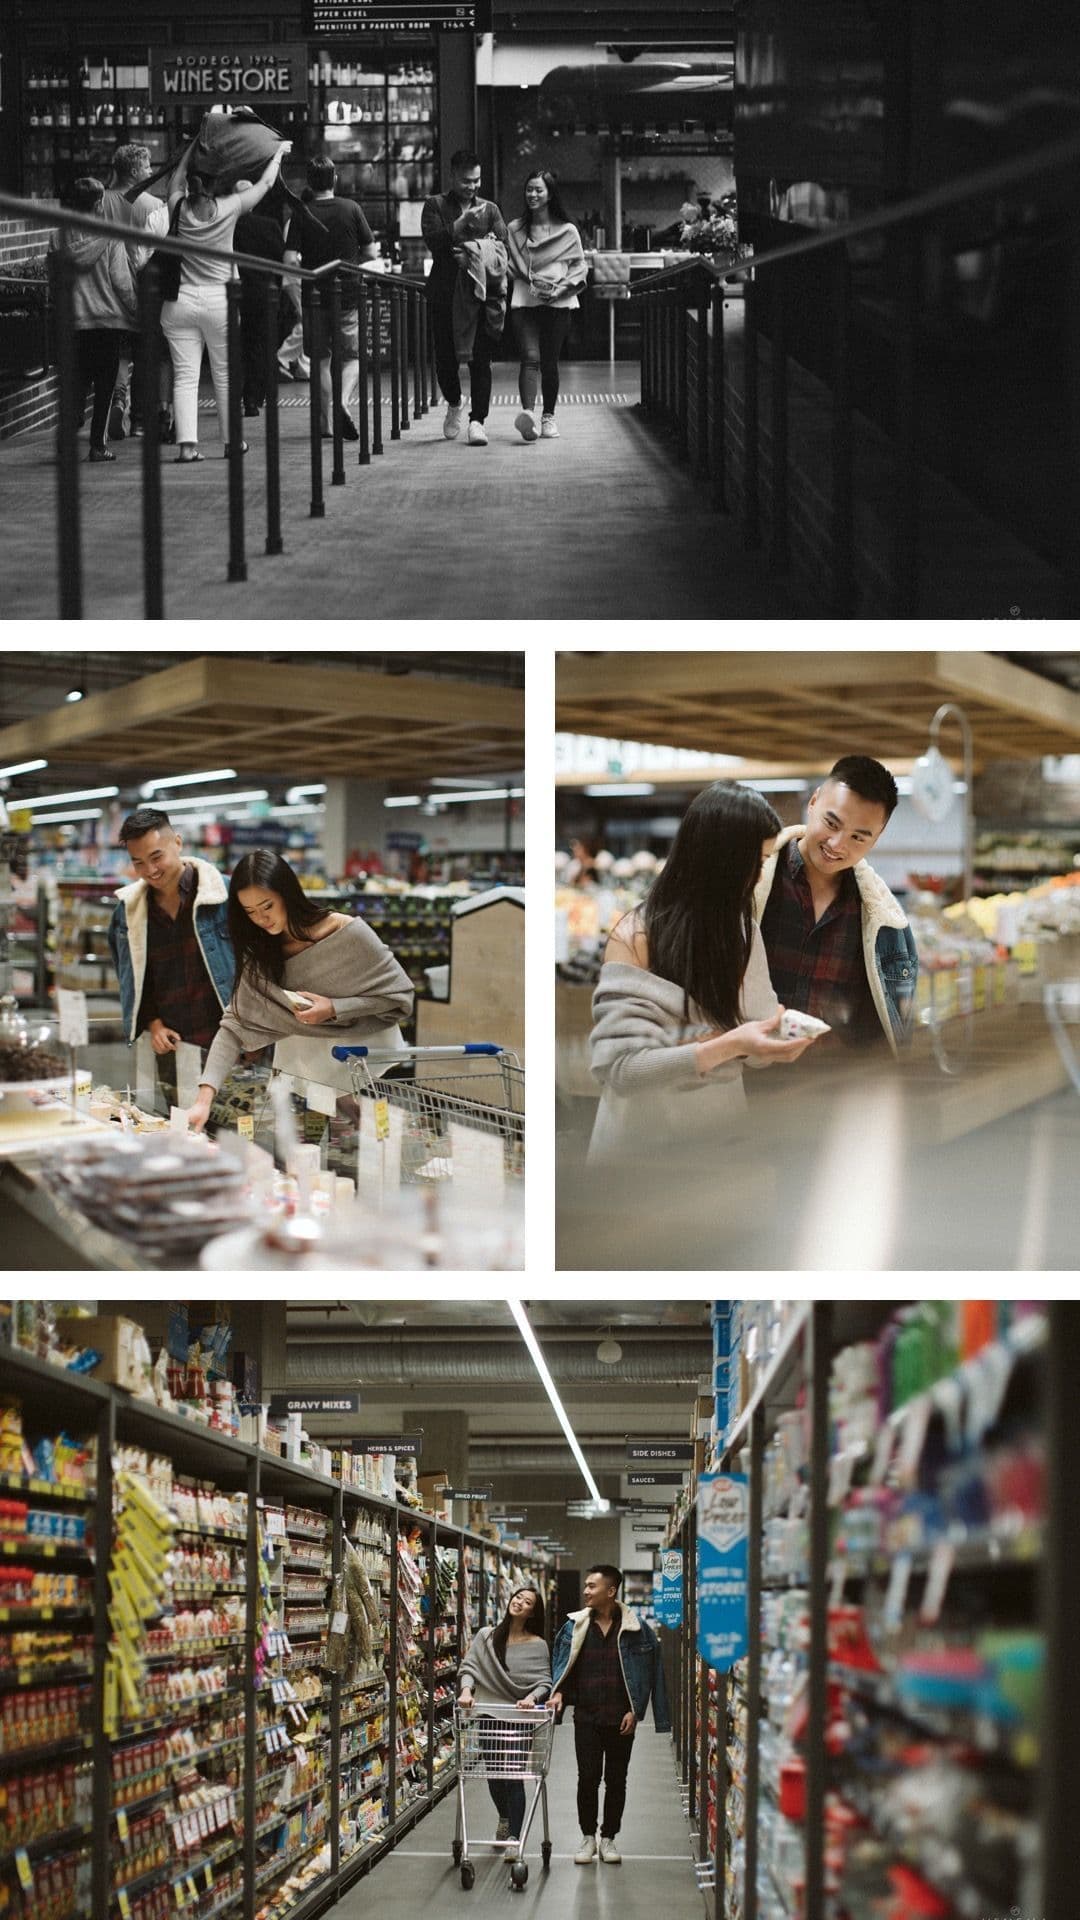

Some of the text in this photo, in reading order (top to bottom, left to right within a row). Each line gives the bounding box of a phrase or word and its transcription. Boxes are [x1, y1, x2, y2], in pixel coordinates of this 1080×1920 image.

[314, 23, 357, 31] AMENITIES
[369, 22, 405, 30] PARENTS
[176, 55, 241, 66] BODEGA
[163, 68, 290, 92] WINE STORE
[287, 1400, 352, 1410] GRAVY MIXES
